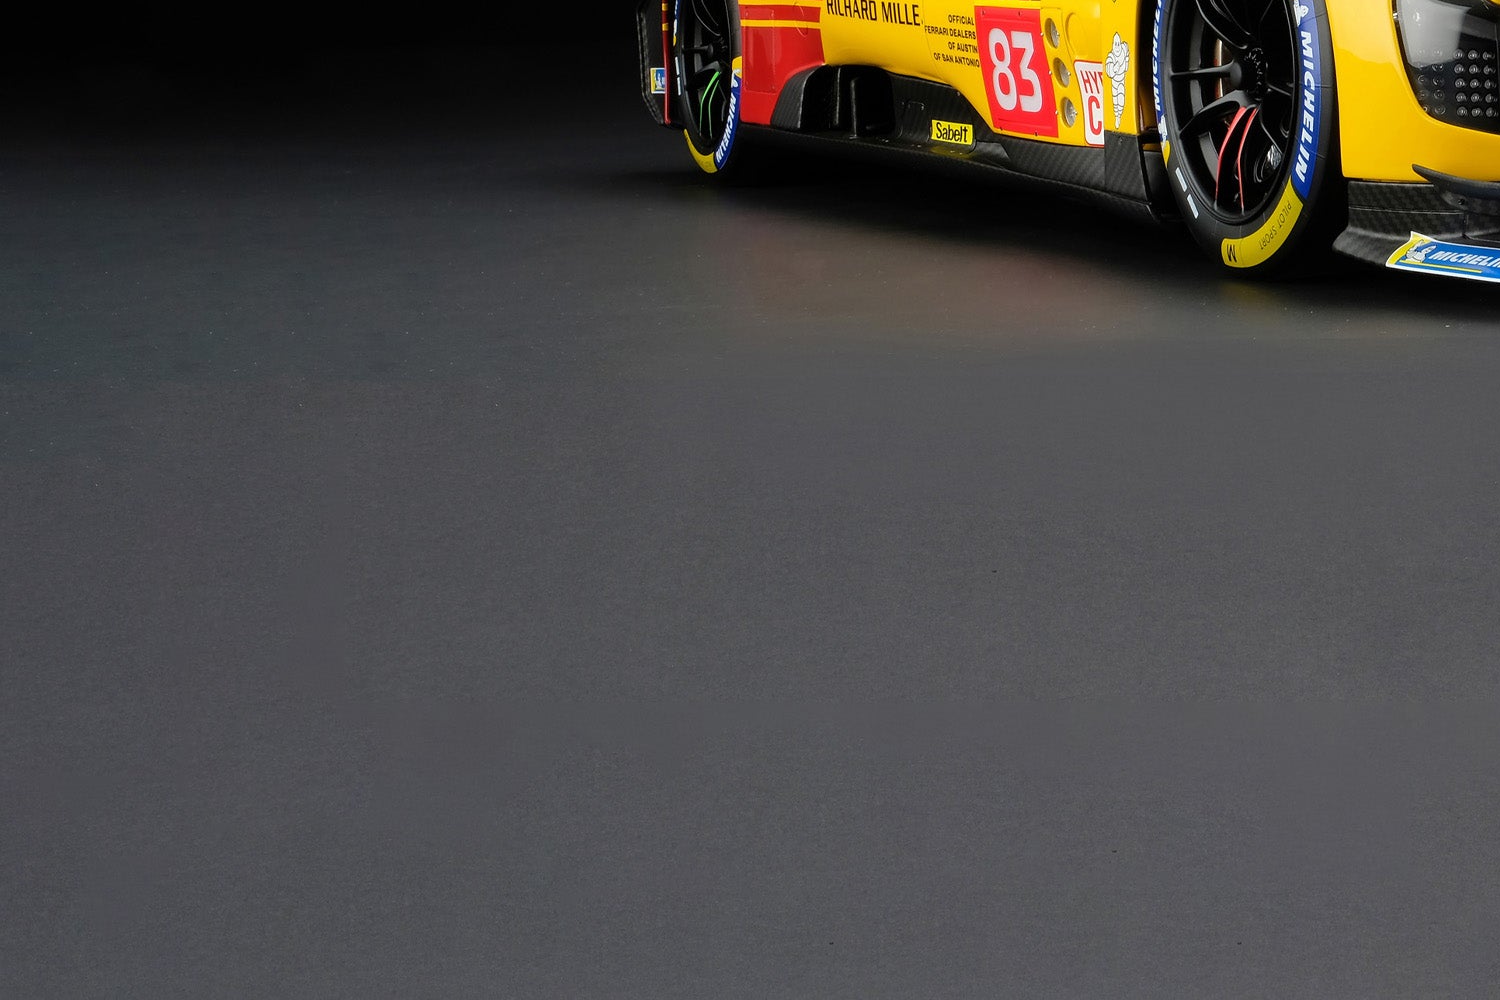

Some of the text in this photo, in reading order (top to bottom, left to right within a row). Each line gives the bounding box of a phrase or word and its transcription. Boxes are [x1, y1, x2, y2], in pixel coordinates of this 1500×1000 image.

[881, 1, 921, 26] MILLE
[948, 14, 975, 26] OFFICIAL
[924, 25, 977, 40] FERRARI DEALERS
[948, 41, 978, 53] OF AUSTIN
[933, 52, 980, 68] OF SAN ANTONIO
[988, 27, 1043, 113] 83
[1295, 31, 1315, 183] MICHELIN
[716, 91, 737, 163] MICHELIN
[936, 121, 969, 143] Sabelt
[1258, 200, 1292, 251] PILOT SPORT
